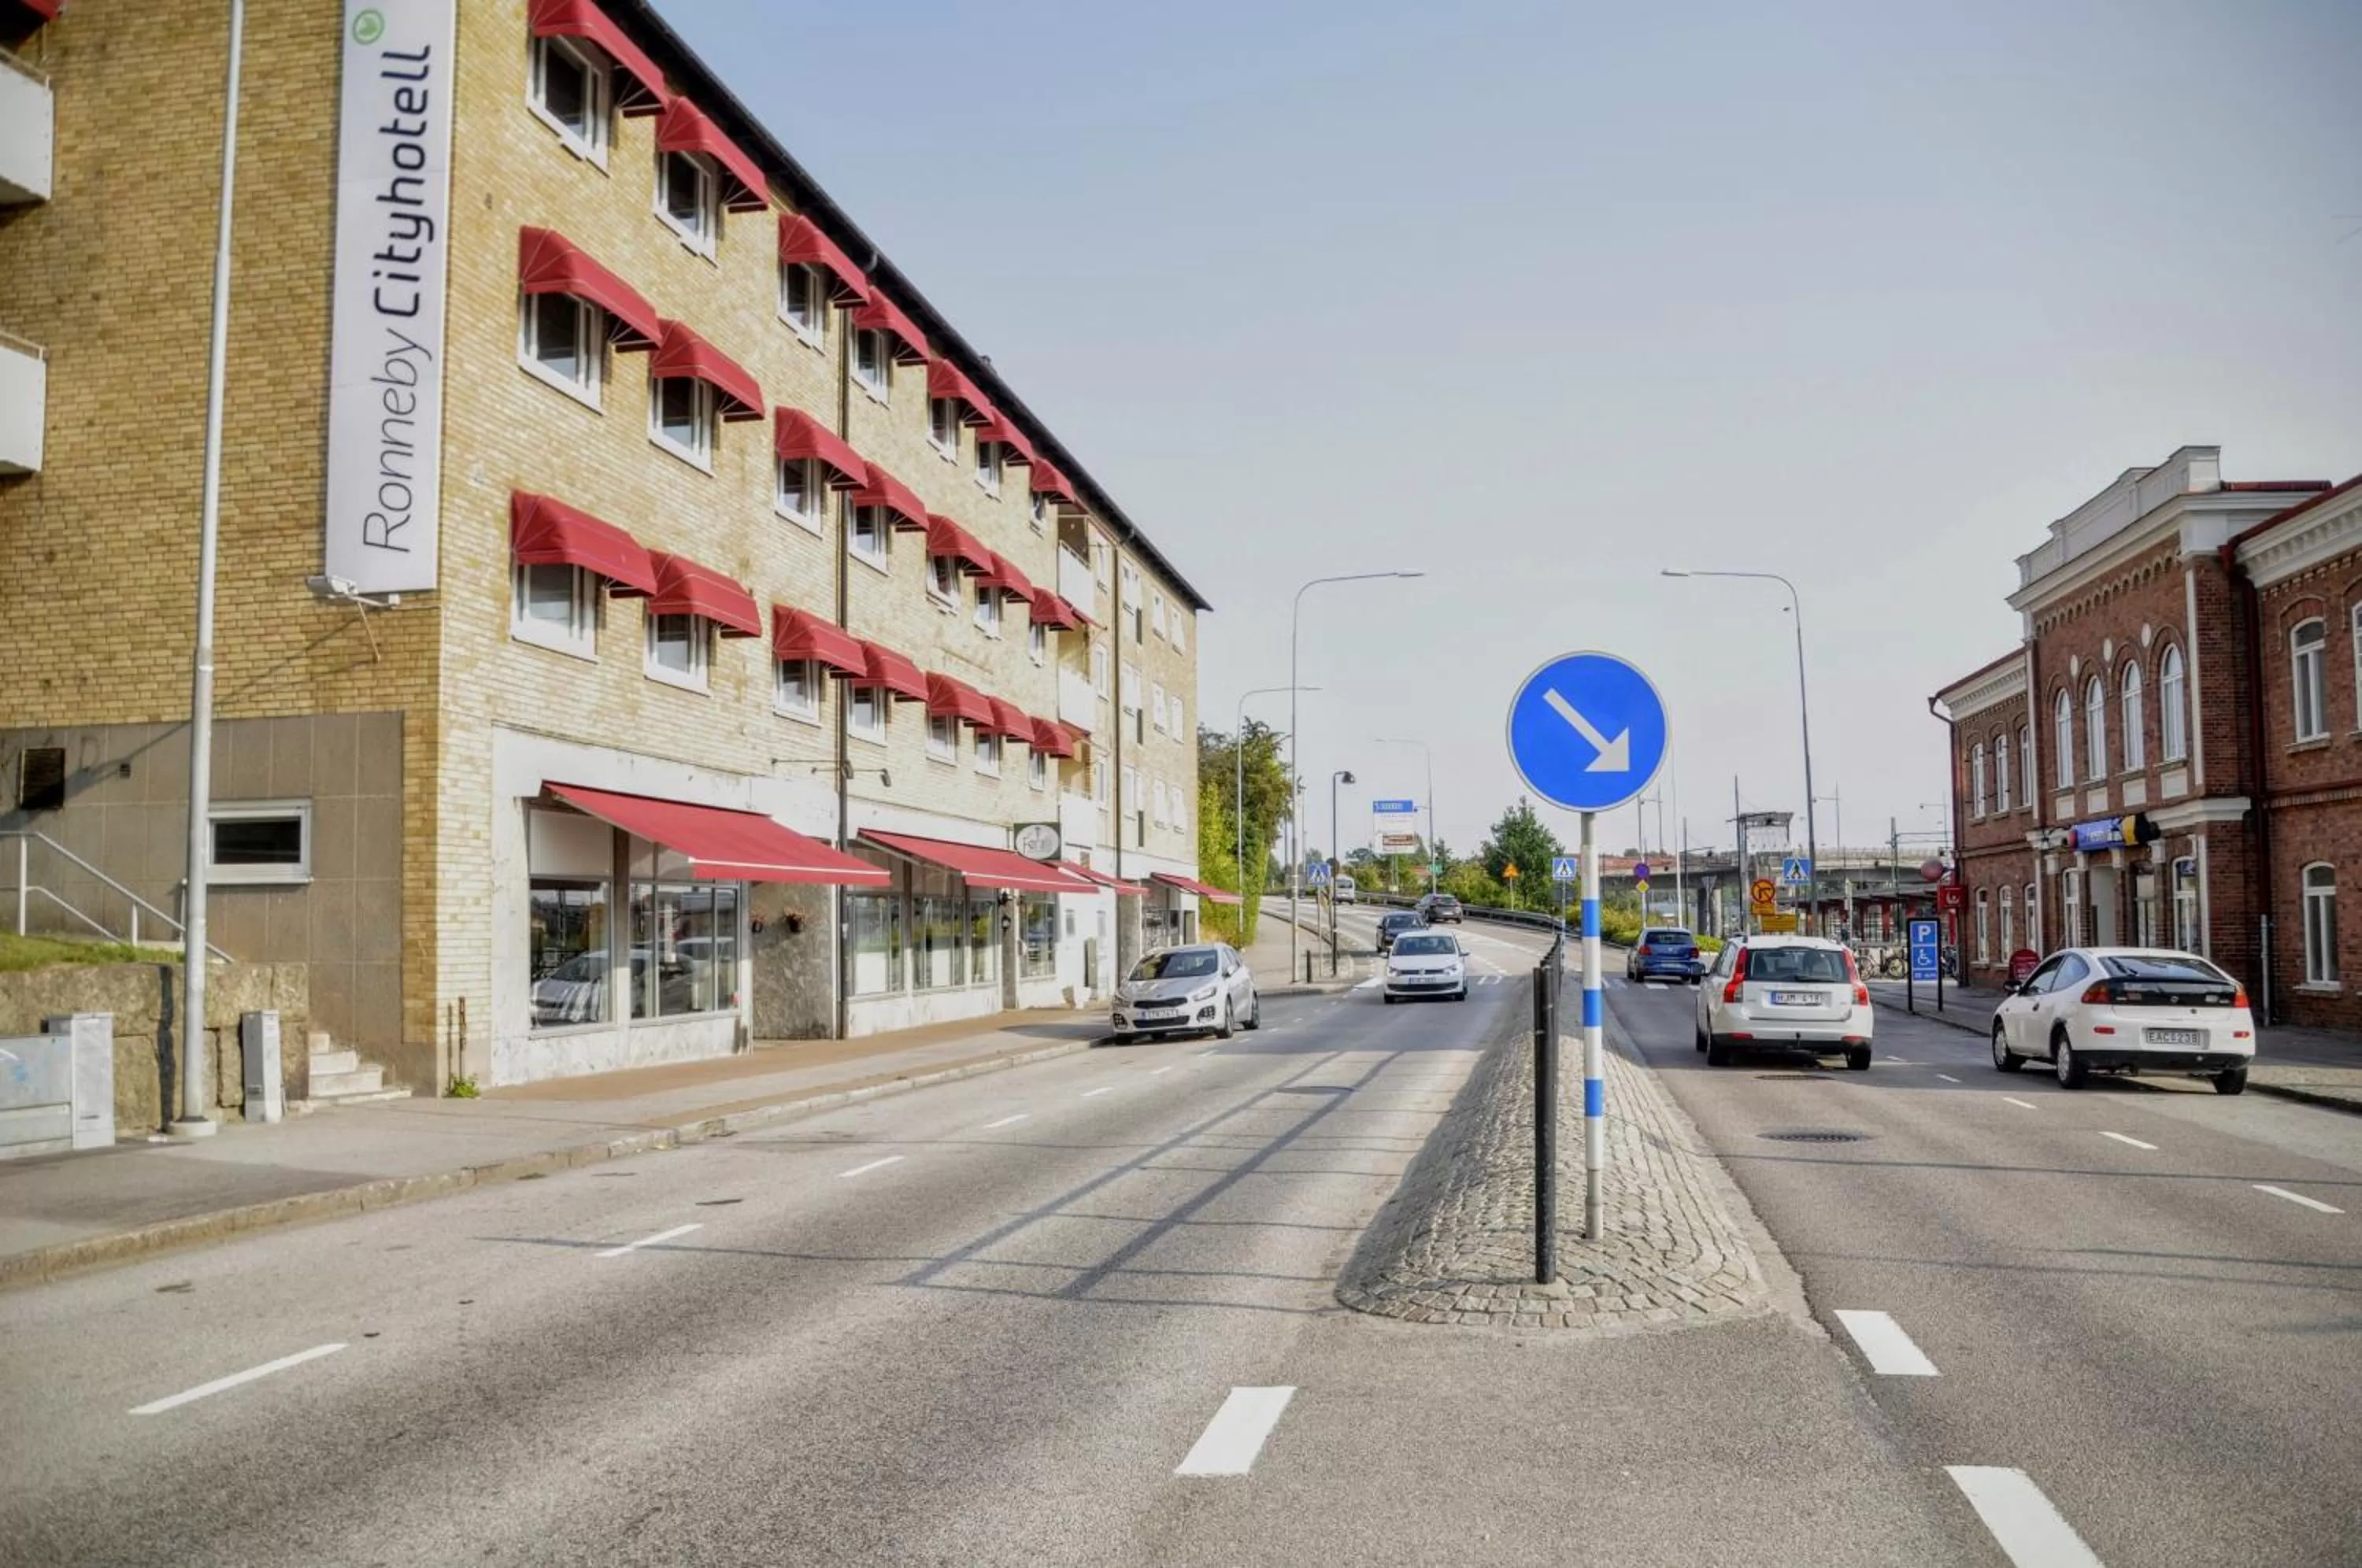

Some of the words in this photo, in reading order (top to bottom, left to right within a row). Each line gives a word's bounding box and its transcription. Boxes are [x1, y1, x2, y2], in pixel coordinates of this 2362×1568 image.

[372, 44, 435, 316] Cityhotell
[362, 327, 432, 553] Ronneby
[1917, 925, 1931, 942] P
